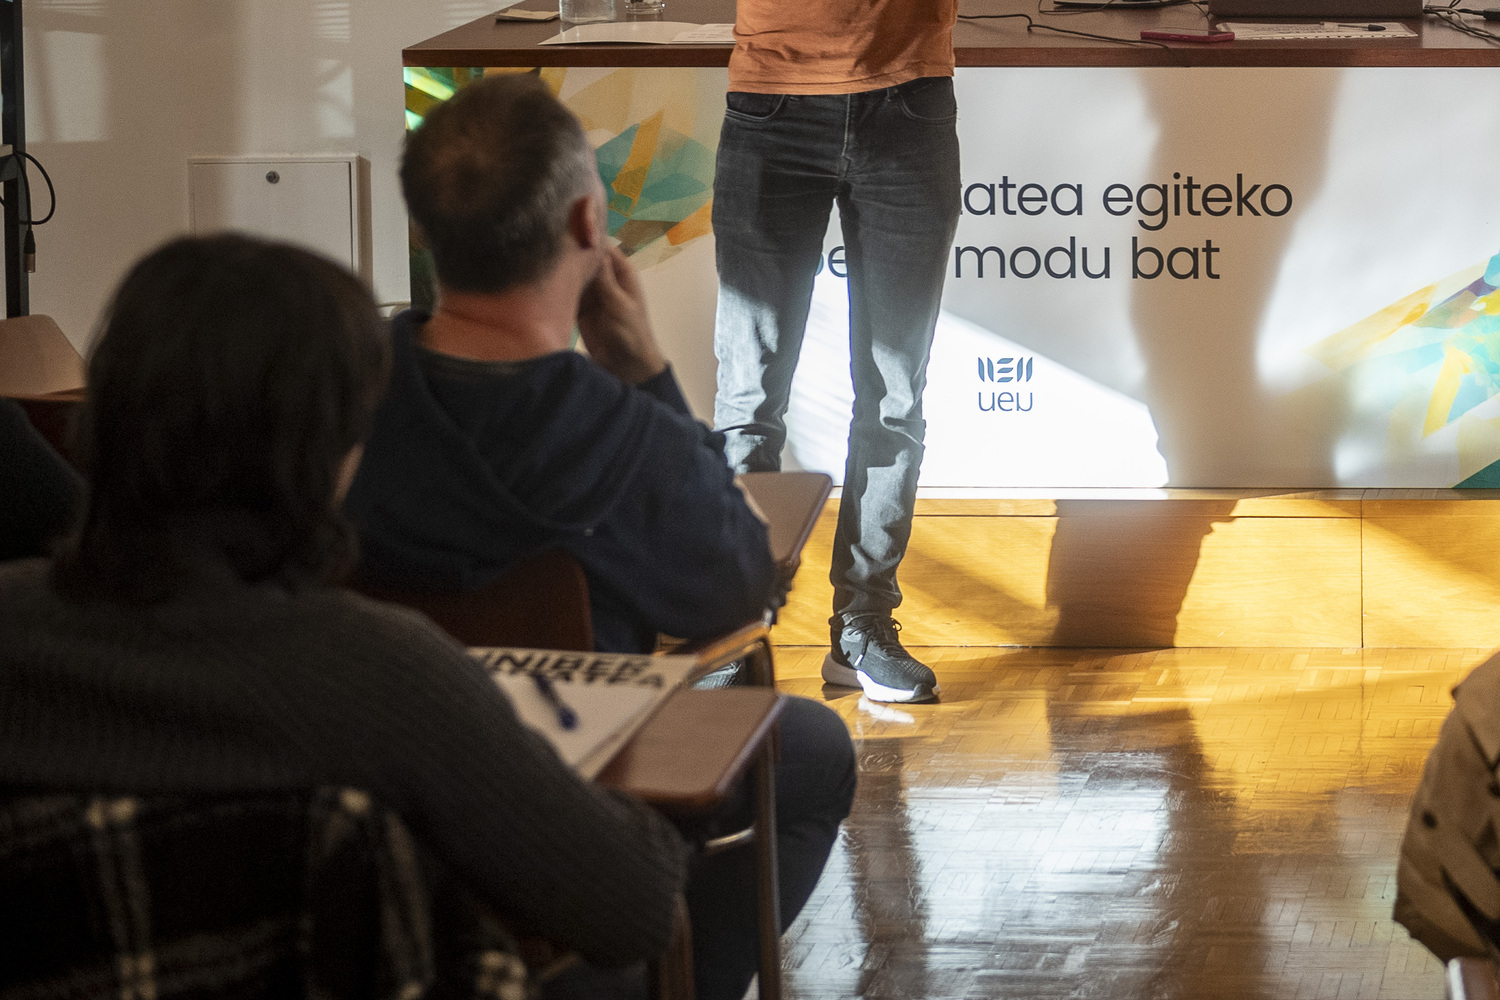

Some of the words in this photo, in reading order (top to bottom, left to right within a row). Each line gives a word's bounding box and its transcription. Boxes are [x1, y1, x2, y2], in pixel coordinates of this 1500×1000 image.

[960, 175, 1083, 216] atea
[1101, 171, 1293, 231] egiteko
[954, 236, 1110, 279] modu
[1131, 235, 1220, 280] bat
